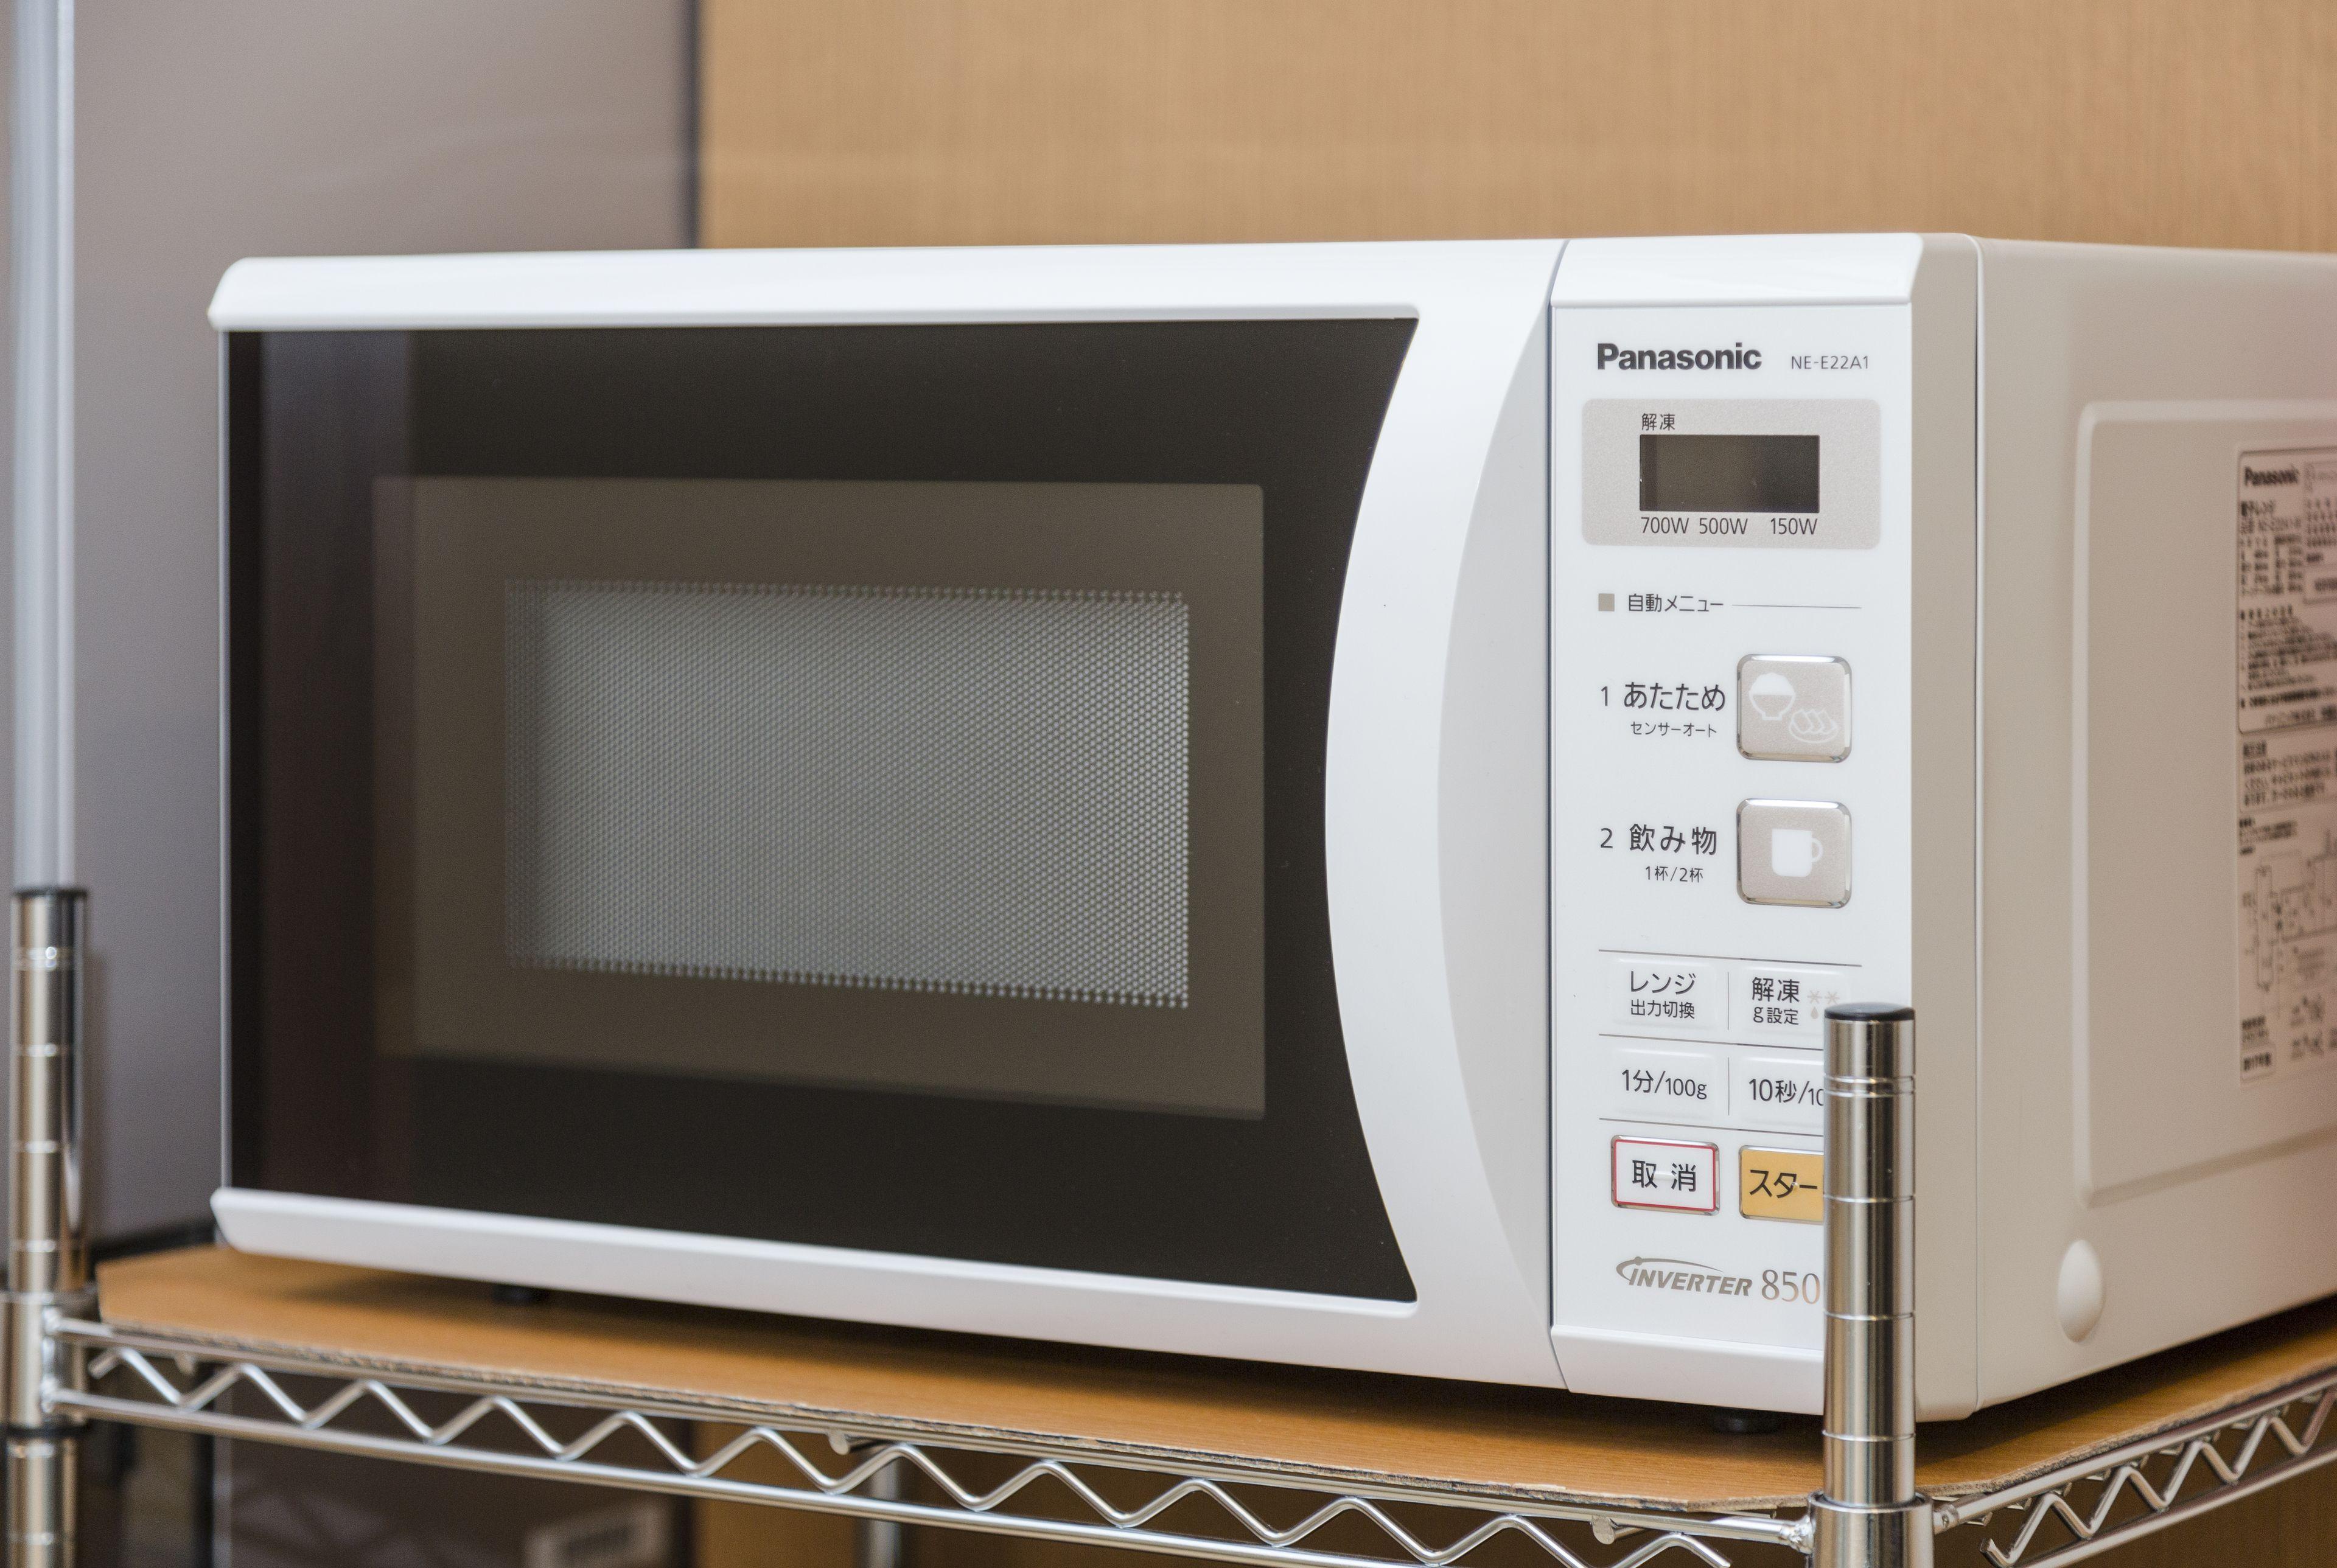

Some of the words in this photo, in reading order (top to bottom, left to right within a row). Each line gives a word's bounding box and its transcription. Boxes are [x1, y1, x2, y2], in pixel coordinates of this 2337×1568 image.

[1598, 342, 1762, 370] Panasonic
[1792, 356, 1868, 369] NE-E22A1
[1642, 413, 1675, 431] 解凍
[1641, 517, 1689, 534] 700W
[1699, 518, 1748, 534] 500W
[1770, 518, 1818, 535] 150W
[1629, 593, 1724, 612] 自動メニュー
[1601, 686, 1608, 706] 1
[1624, 681, 1725, 711] あたため
[1630, 722, 1716, 737] センサーオート
[1601, 828, 1613, 848] 2
[1629, 823, 1717, 855] 飲み物
[1646, 866, 1703, 883] 1杯/2杯
[1631, 971, 1696, 995] レンジ
[1752, 977, 1800, 1003] 解凍
[1631, 999, 1694, 1019] 出力切換
[1622, 1070, 1707, 1099] 1分/100g
[1632, 1160, 1696, 1192] 取消
[1629, 1268, 1753, 1297] INVERTER
[1762, 1269, 1820, 1304] 850
